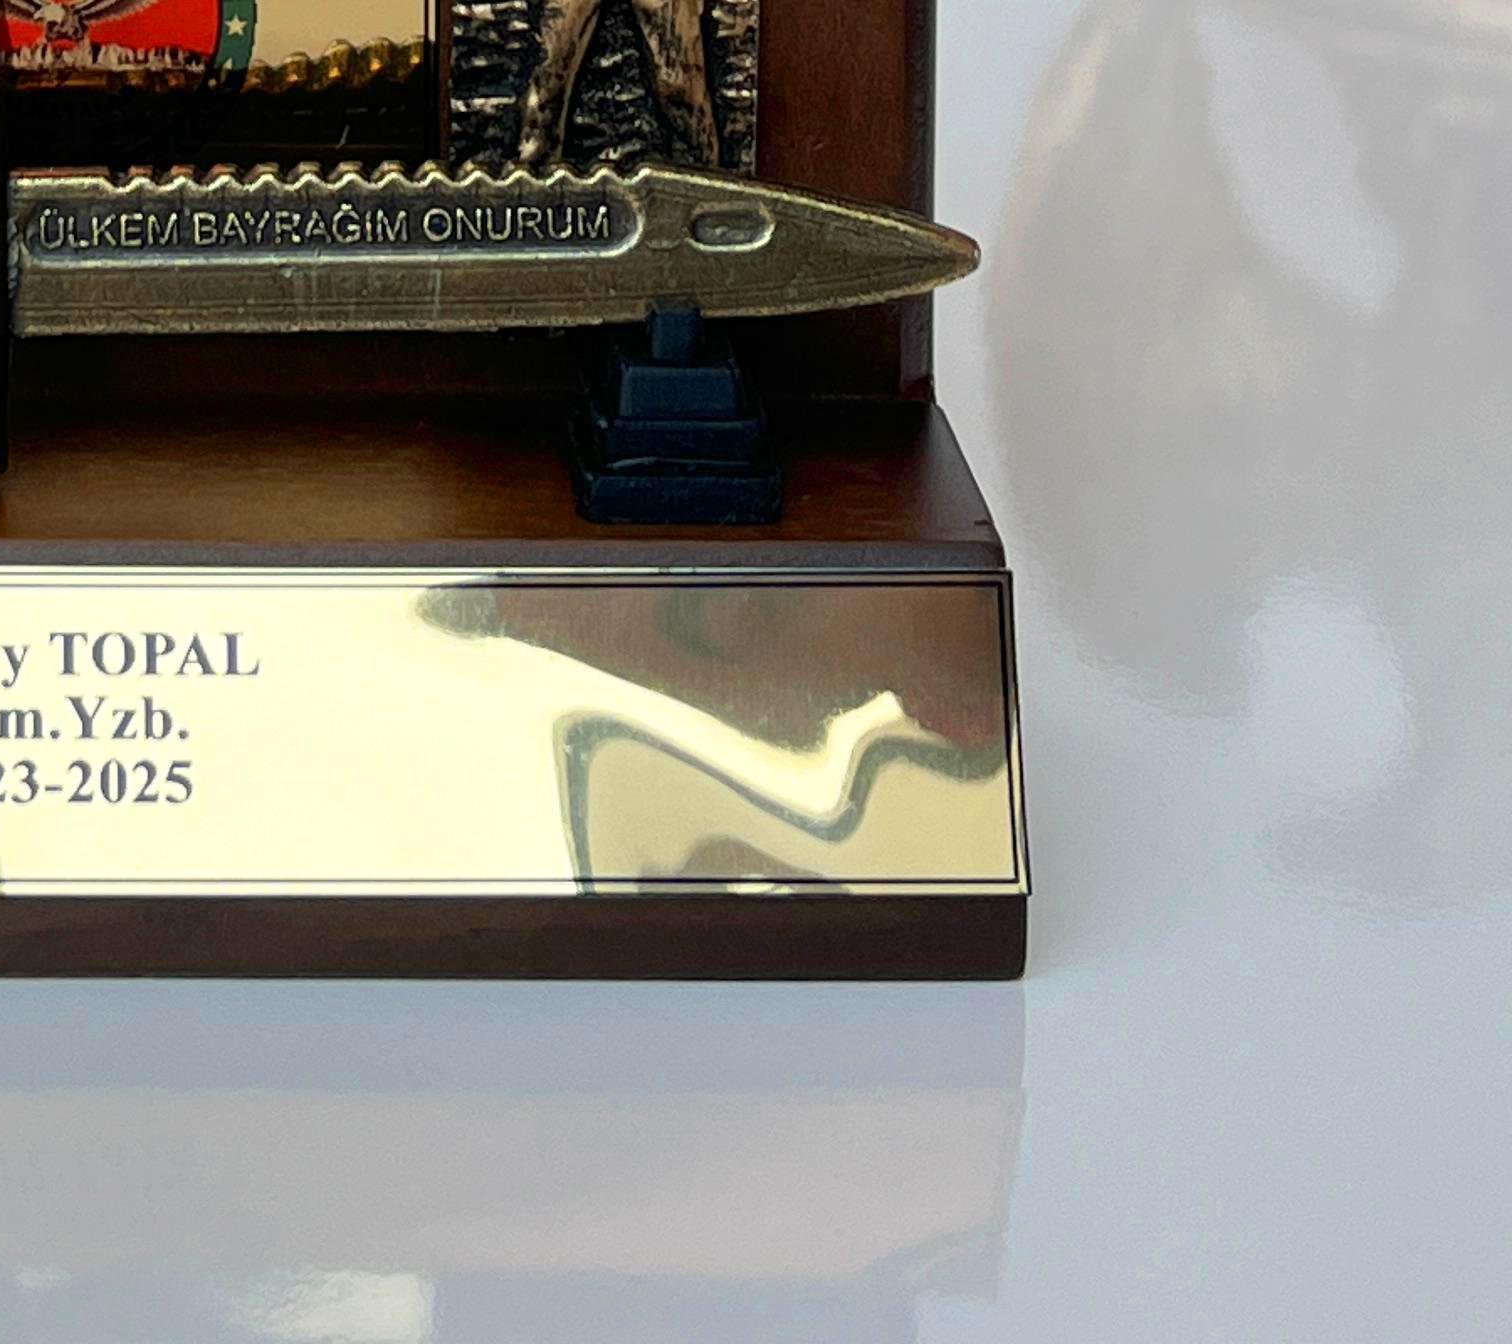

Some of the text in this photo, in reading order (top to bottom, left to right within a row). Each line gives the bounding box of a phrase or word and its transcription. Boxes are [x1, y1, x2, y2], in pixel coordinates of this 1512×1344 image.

[39, 204, 611, 248] ÜLKEM BAYRAĞIM ONURUM
[49, 632, 260, 676] TOPAL
